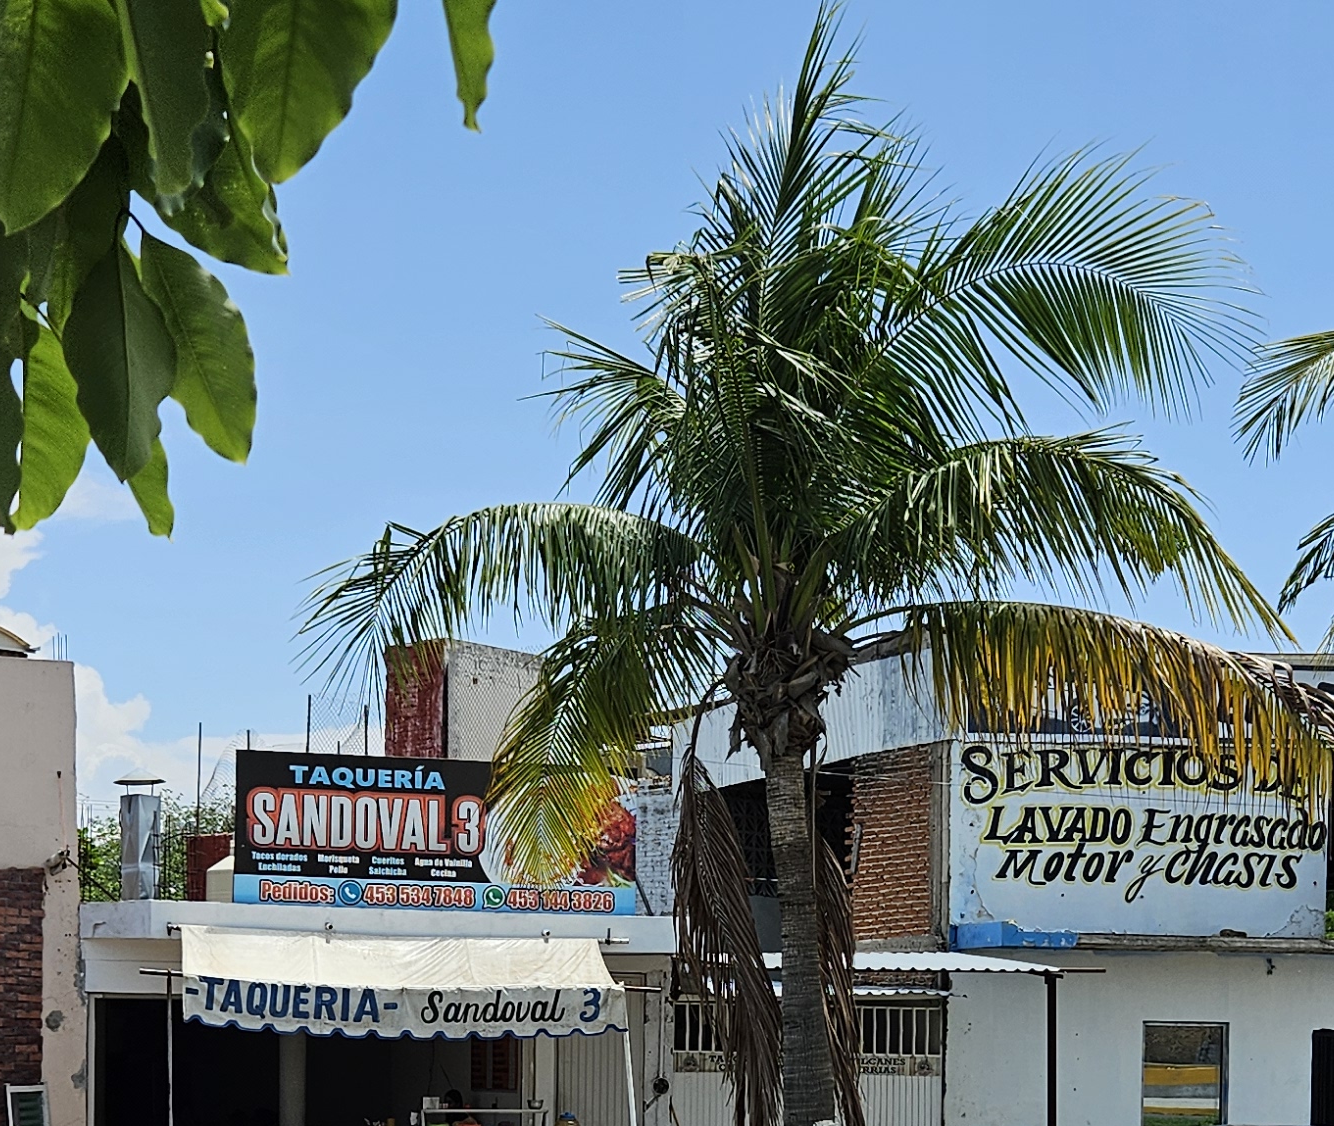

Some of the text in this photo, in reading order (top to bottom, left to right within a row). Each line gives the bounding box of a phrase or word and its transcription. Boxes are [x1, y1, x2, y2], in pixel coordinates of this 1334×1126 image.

[289, 765, 446, 790] TAQUERÍA
[253, 792, 480, 853] SANDOVAL 3
[980, 805, 1133, 845] LAVADO
[992, 843, 1134, 886] Motor
[259, 879, 475, 907] Pedidos: 453 534 7848
[507, 889, 614, 911] 453 144 3826
[421, 990, 564, 1024] Sandoval
[578, 989, 602, 1022] 3
